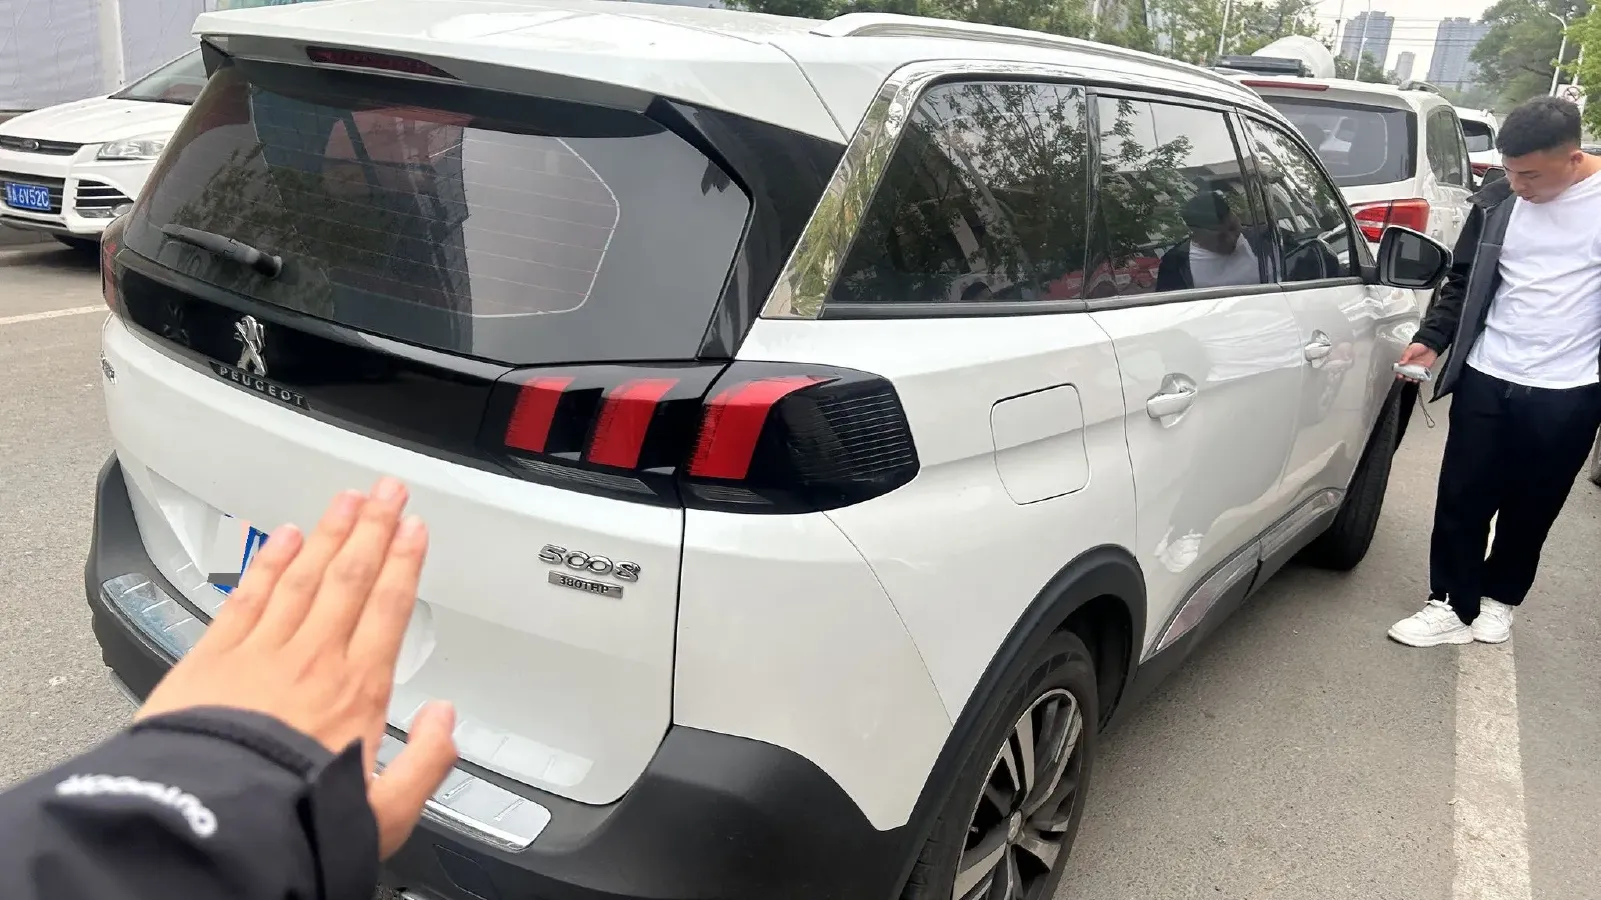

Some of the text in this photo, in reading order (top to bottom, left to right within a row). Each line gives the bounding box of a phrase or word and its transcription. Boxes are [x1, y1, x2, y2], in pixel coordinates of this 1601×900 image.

[219, 366, 303, 405] PEUGEOT
[538, 543, 641, 582] 5008
[559, 576, 610, 594] 380THP
